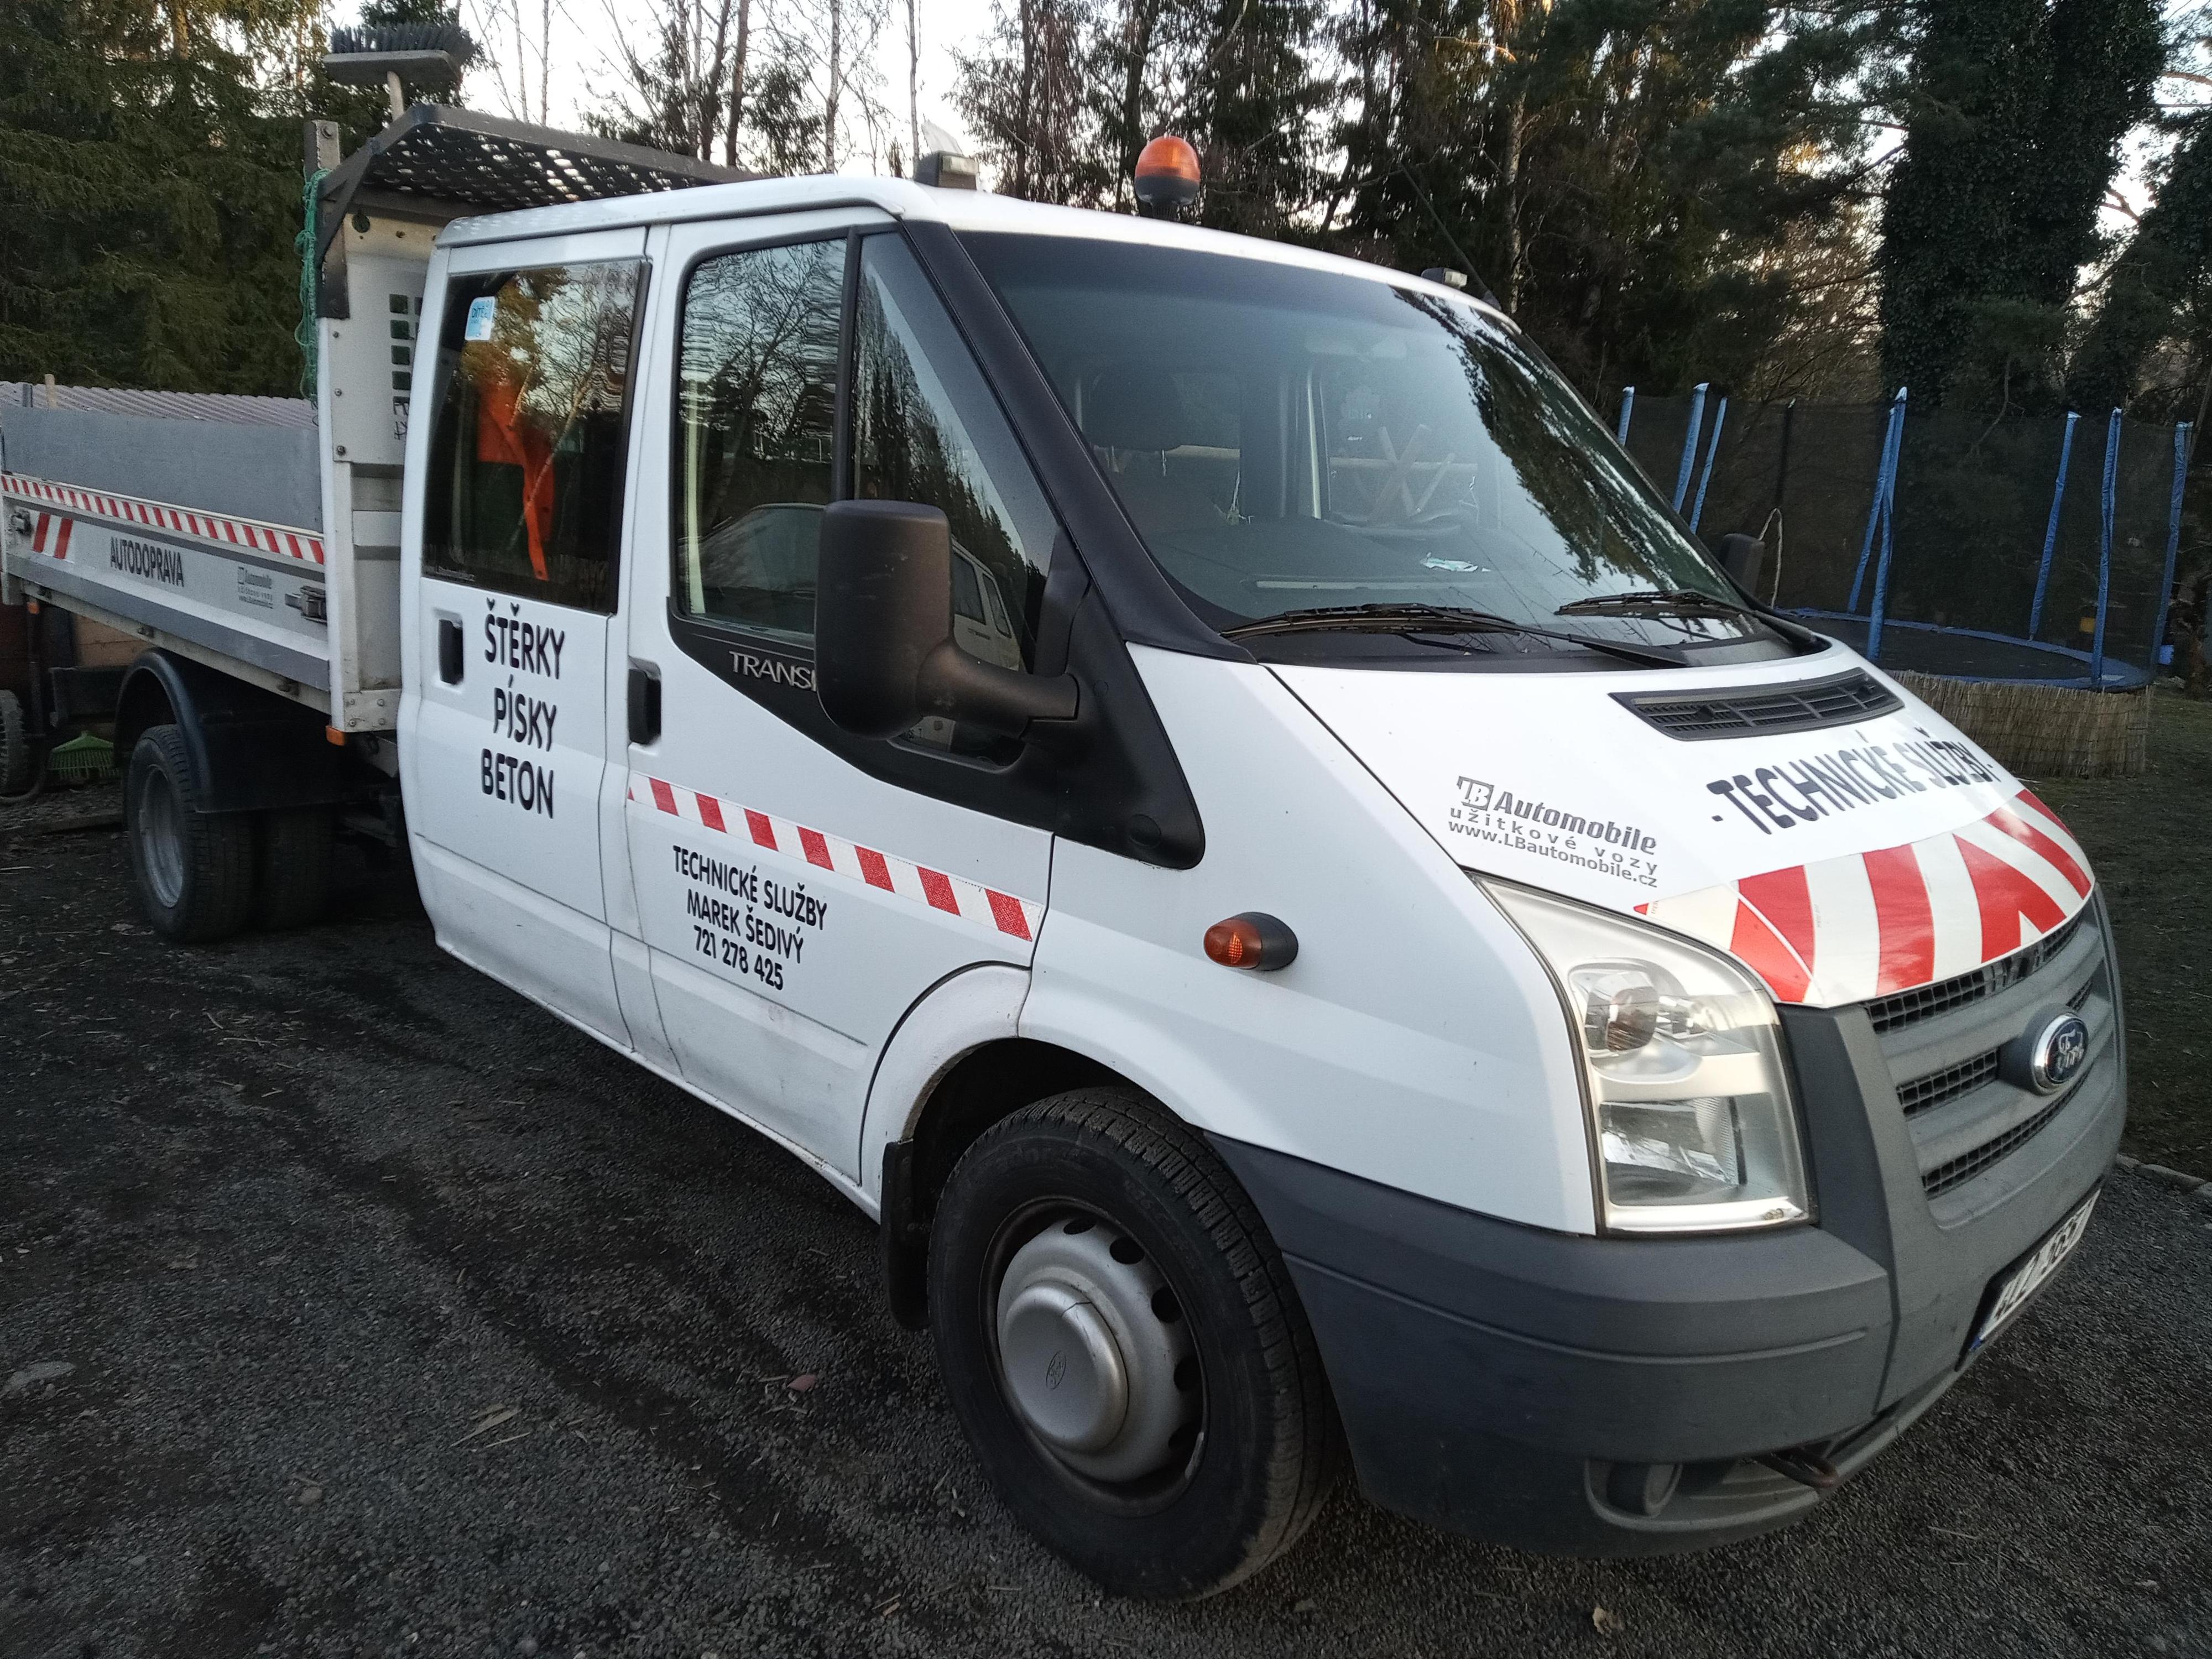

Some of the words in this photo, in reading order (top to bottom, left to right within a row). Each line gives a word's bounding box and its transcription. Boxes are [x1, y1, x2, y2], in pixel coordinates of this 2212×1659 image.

[111, 536, 184, 587] AUTODOPRAVA
[484, 597, 565, 680] ŠTĚRKY
[729, 650, 817, 692] TRANSI
[493, 674, 557, 752] PÍSKY
[481, 748, 554, 819] BETON
[1448, 821, 1657, 888] www.LBautomobile.cz
[1450, 807, 1577, 850] užitkové
[1594, 847, 1658, 875] vozy
[1493, 791, 1657, 855] Automobile
[672, 844, 758, 903] TECHNICKÉ
[764, 882, 827, 931] SLUŽBY
[687, 888, 741, 937] MAREK
[745, 904, 804, 964] ŠEDIVÝ
[693, 925, 717, 959] 721
[722, 938, 749, 974] 278
[753, 954, 784, 990] 425
